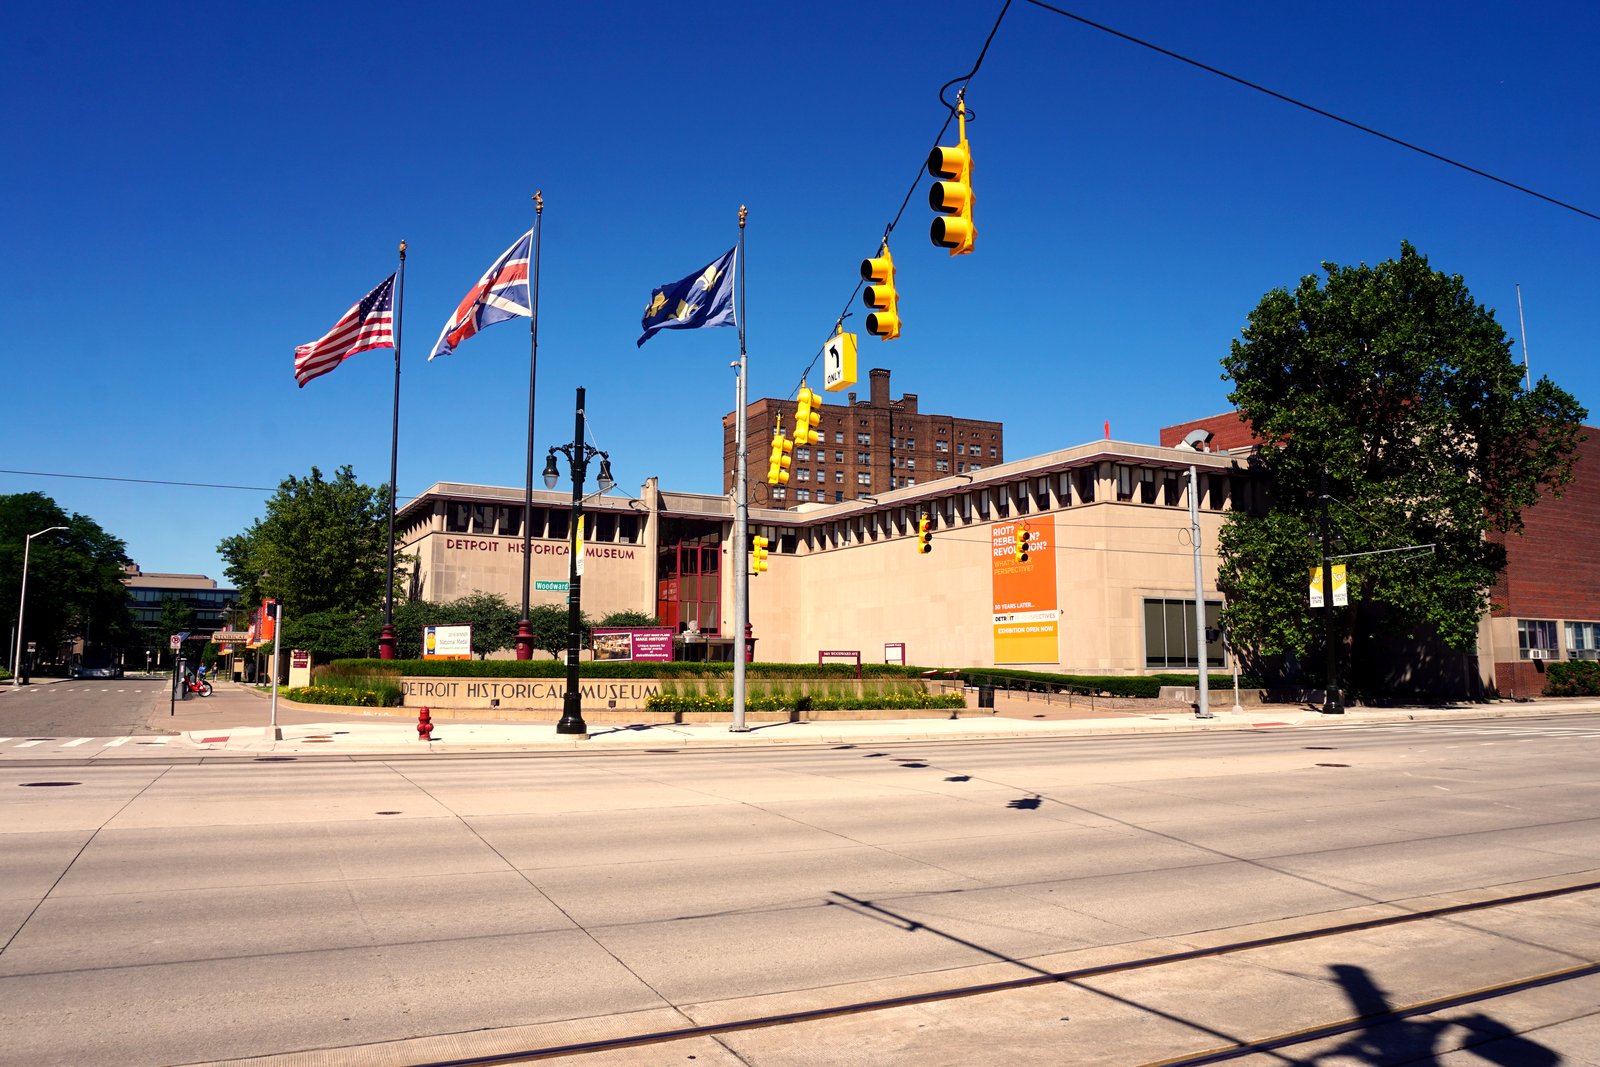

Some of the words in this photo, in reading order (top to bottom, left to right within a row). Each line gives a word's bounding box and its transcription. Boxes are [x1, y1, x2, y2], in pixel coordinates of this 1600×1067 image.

[827, 370, 841, 384] ONLY
[993, 526, 1015, 537] RIOT?
[993, 532, 1040, 547] REBELN?
[446, 539, 499, 552] DETROIT
[508, 543, 570, 555] HISTORICA
[585, 549, 635, 560] MUSEUM
[993, 541, 1047, 557] REVOLION?
[994, 565, 1034, 576] PERSPECTIVE?
[536, 582, 569, 590] Woodward
[401, 682, 459, 698] DETROIT
[467, 683, 566, 700] HISTORICAL
[580, 684, 659, 700] MUSEUM
